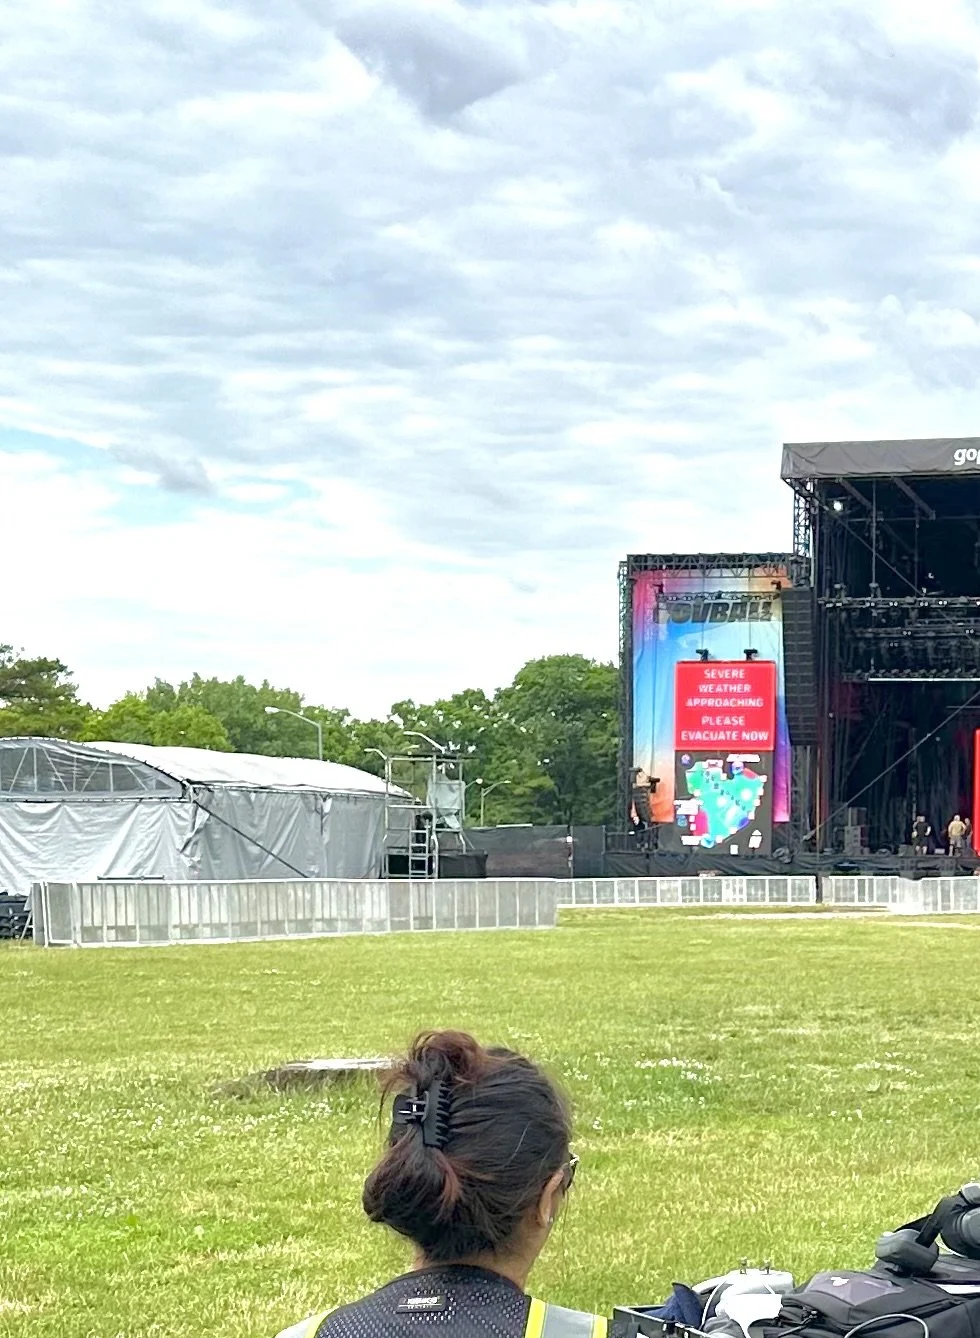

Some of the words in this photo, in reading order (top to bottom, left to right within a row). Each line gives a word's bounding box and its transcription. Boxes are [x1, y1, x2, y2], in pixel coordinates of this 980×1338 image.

[704, 669, 745, 679] SEVERE
[699, 683, 752, 693] WEATHER
[686, 697, 764, 707] APPROACHING
[702, 716, 745, 726] PLEASE
[681, 731, 738, 741] EVACUATE
[741, 731, 769, 741] NOW
